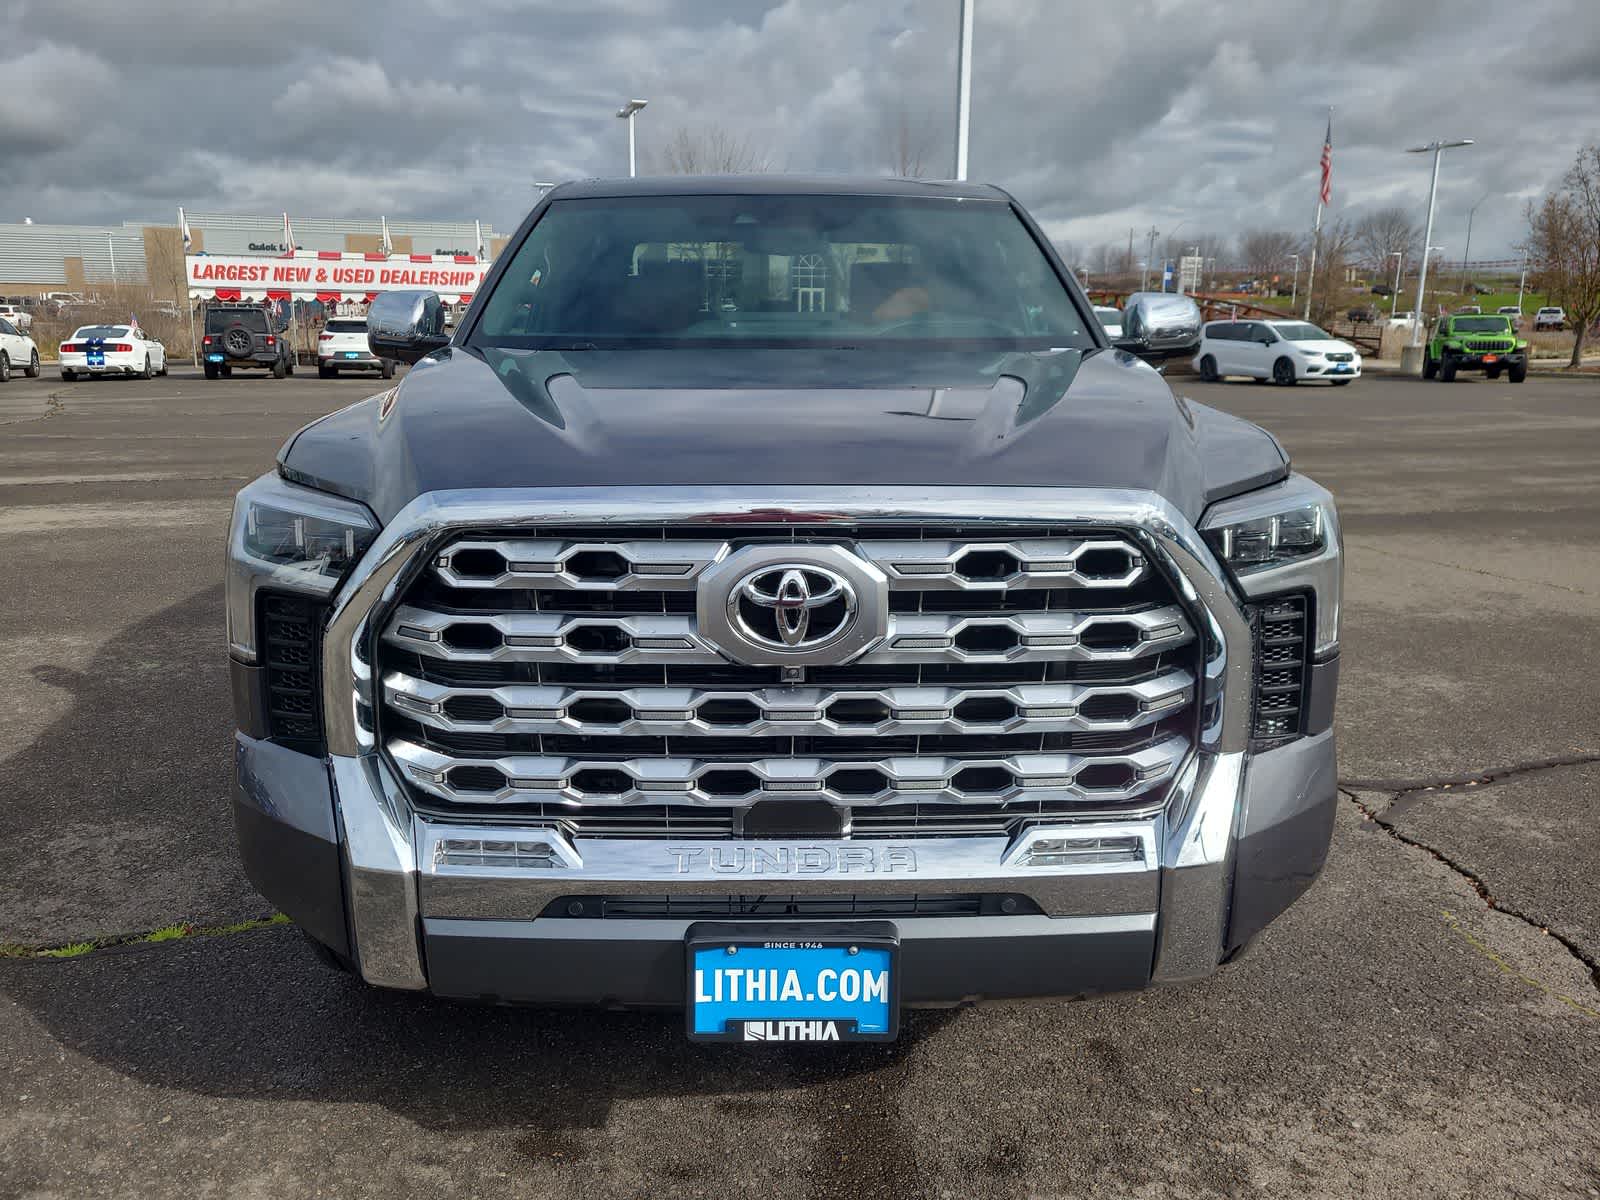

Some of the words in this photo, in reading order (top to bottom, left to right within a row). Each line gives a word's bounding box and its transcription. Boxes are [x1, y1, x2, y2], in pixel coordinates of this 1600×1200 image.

[248, 243, 277, 252] Quick
[193, 264, 269, 281] LARGEST
[273, 266, 311, 282] NEW
[315, 267, 328, 283] &
[333, 268, 375, 284] USED
[380, 269, 474, 286] DEALERSHIP
[667, 846, 918, 874] TUNDRA
[695, 969, 889, 1003] LITHIA.COM
